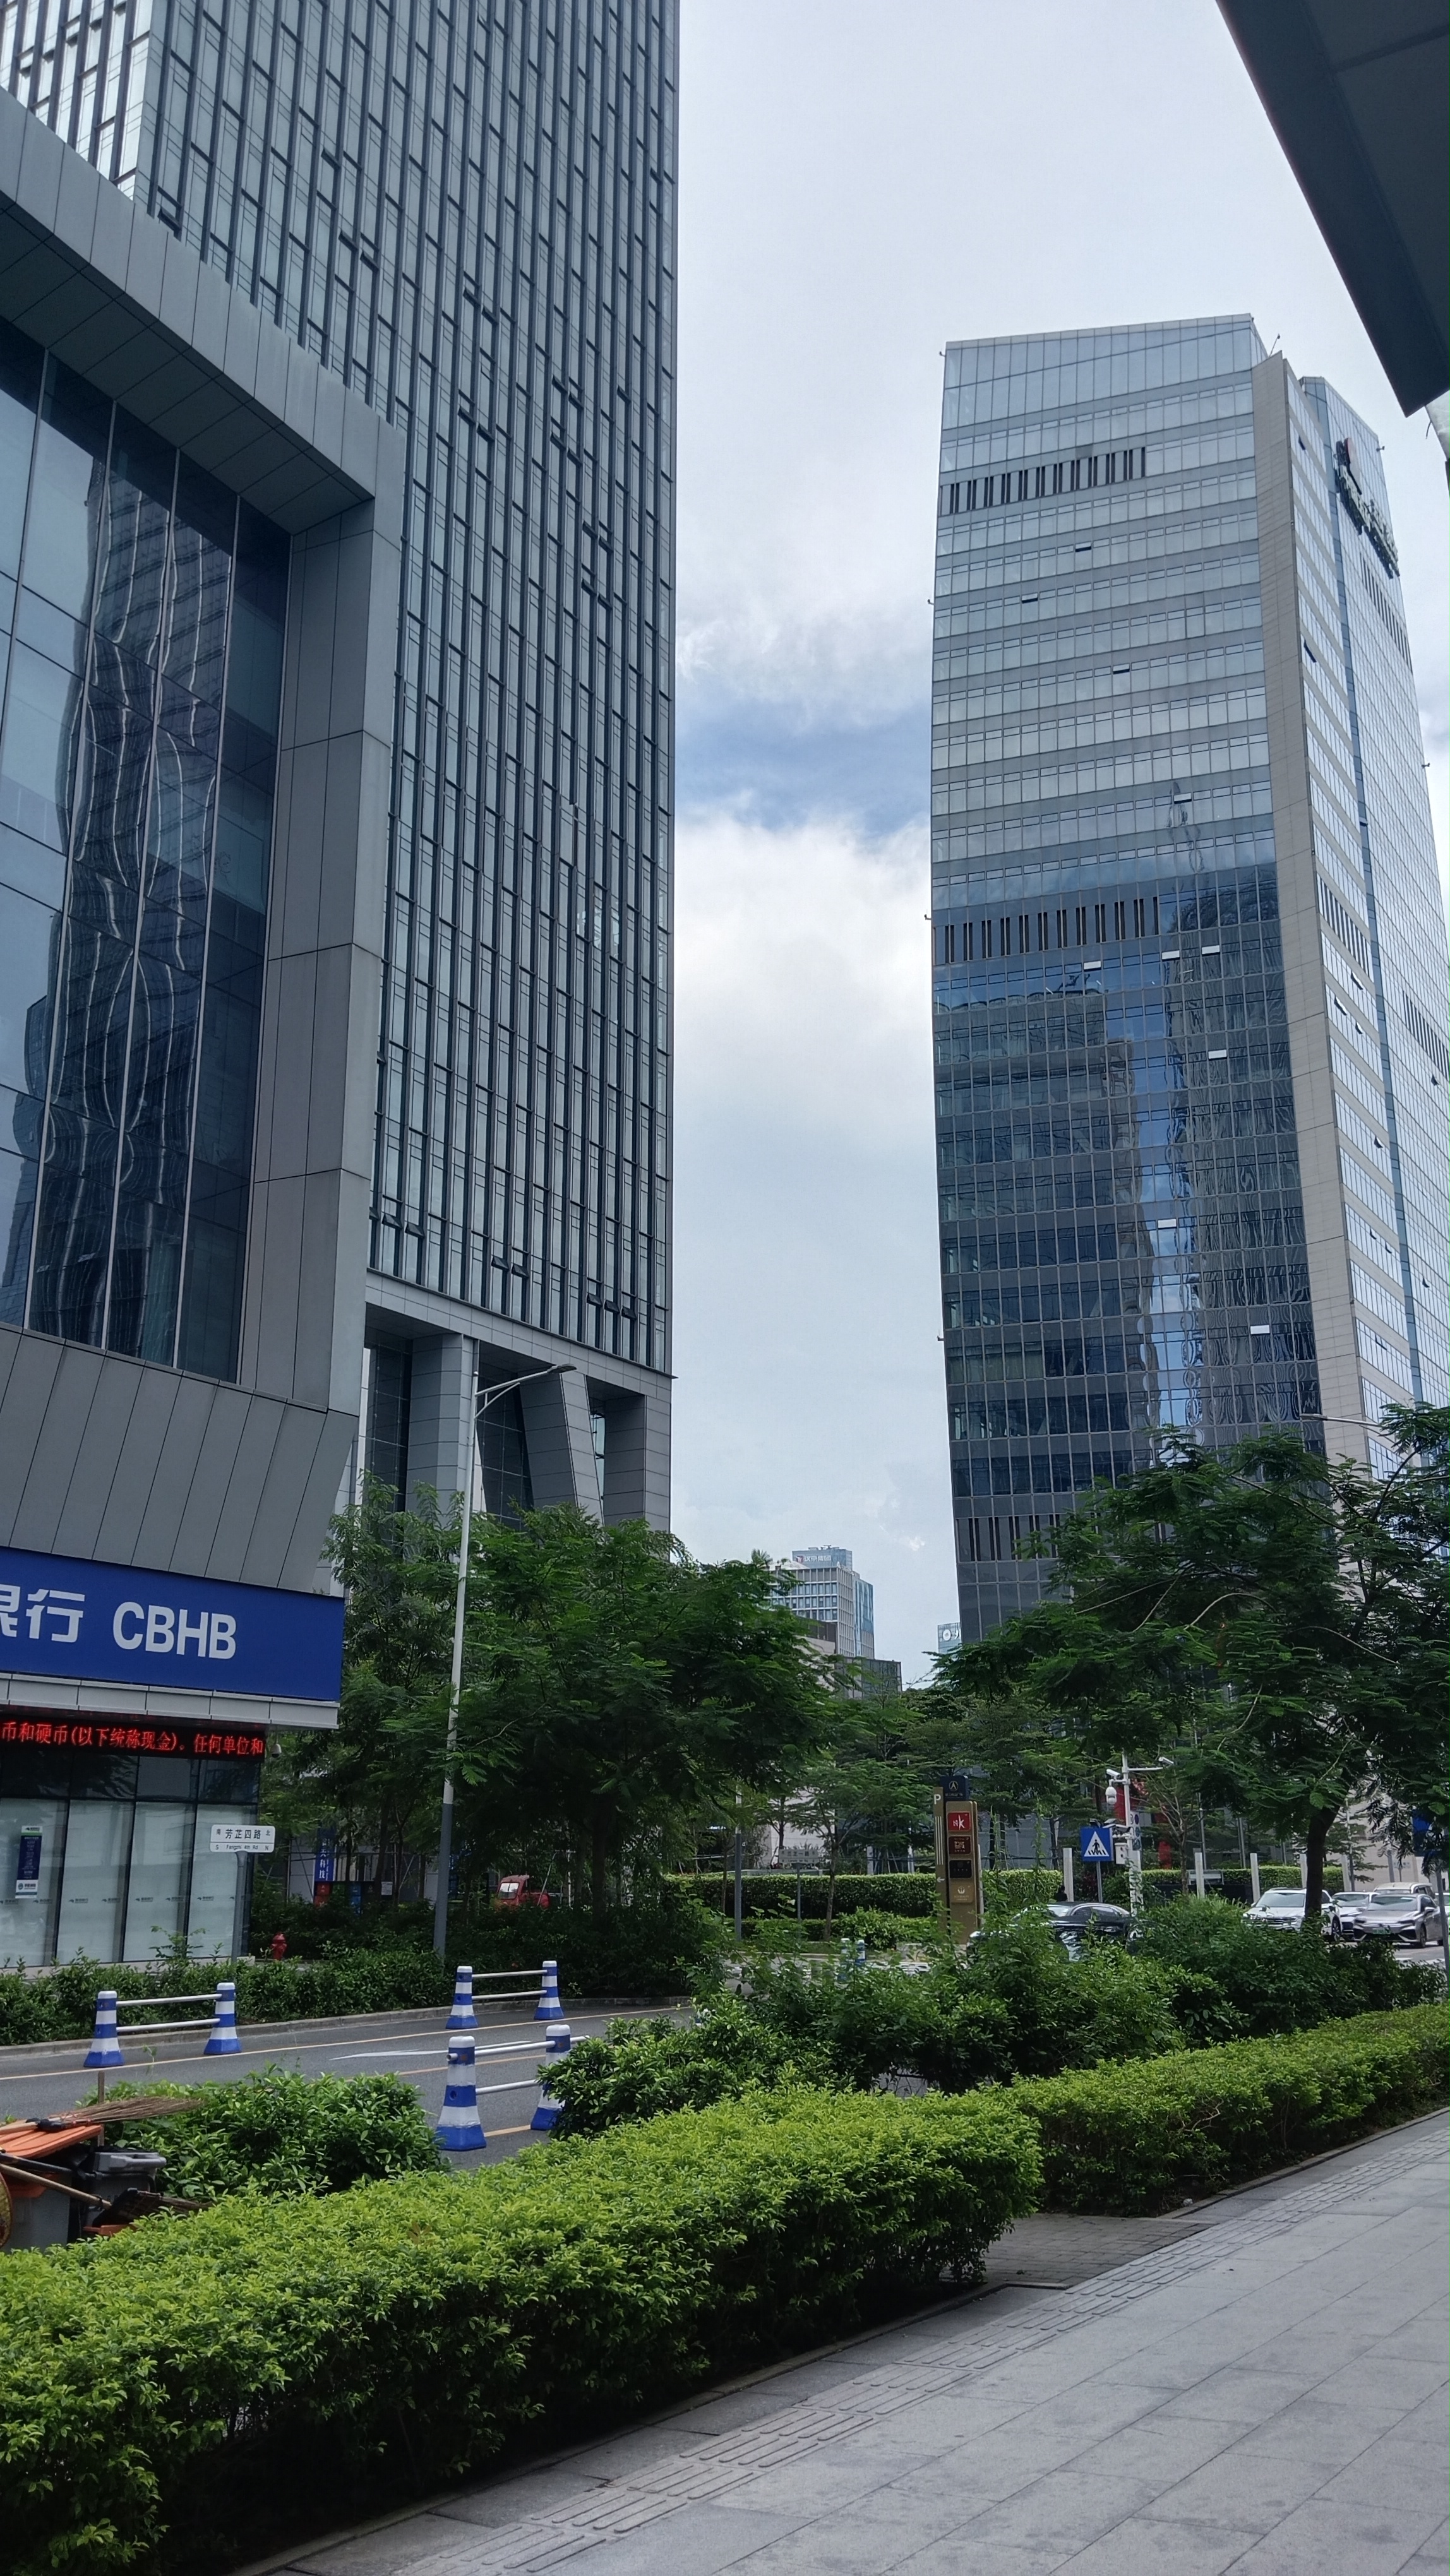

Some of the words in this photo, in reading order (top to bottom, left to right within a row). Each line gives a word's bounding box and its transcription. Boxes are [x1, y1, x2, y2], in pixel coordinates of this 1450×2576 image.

[113, 1602, 237, 1659] CBHB
[934, 1794, 941, 1804] P
[225, 1828, 261, 1840] 芳芷四路
